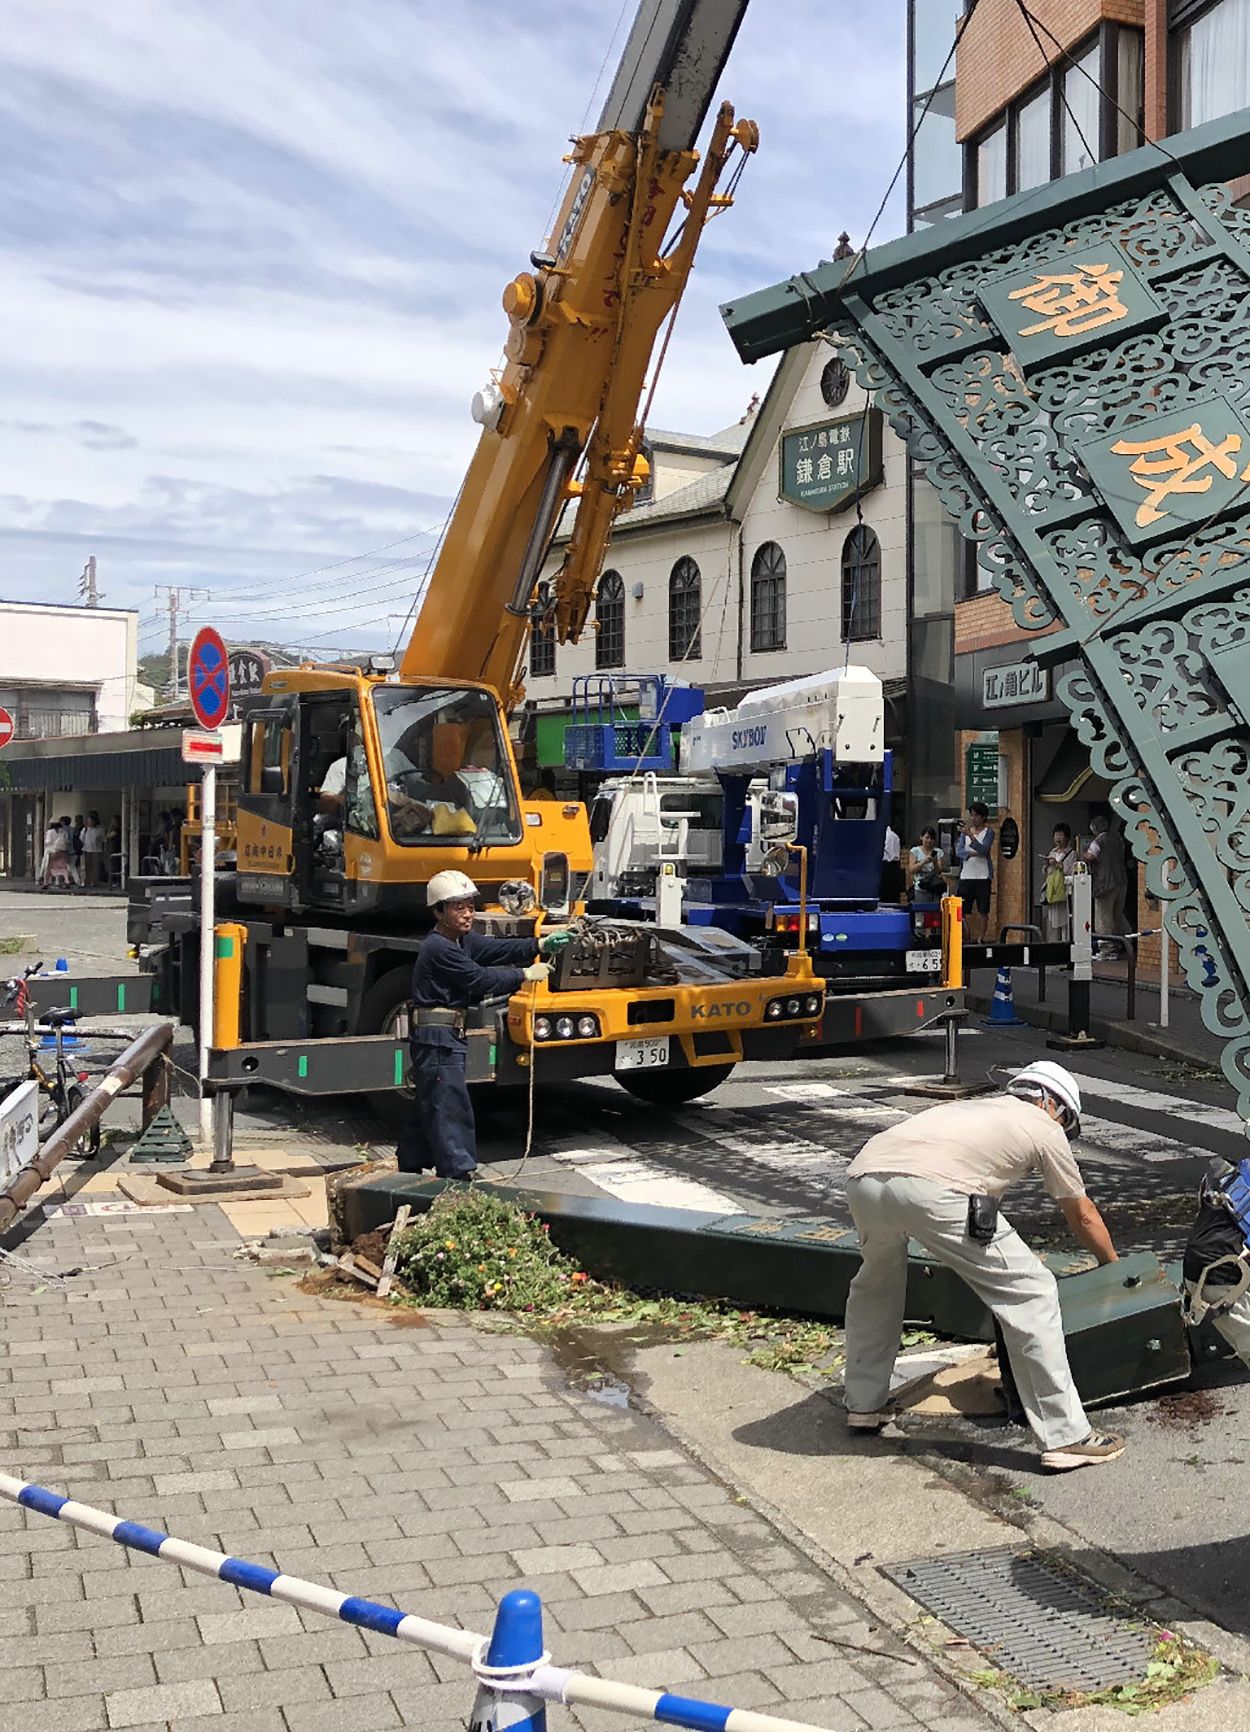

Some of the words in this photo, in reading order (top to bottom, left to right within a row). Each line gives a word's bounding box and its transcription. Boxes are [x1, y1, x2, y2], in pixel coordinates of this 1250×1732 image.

[798, 425, 851, 452] 江ノ島電鉄
[796, 448, 854, 486] 鎌倉駅
[828, 481, 849, 492] STATION
[690, 1001, 753, 1019] KATO
